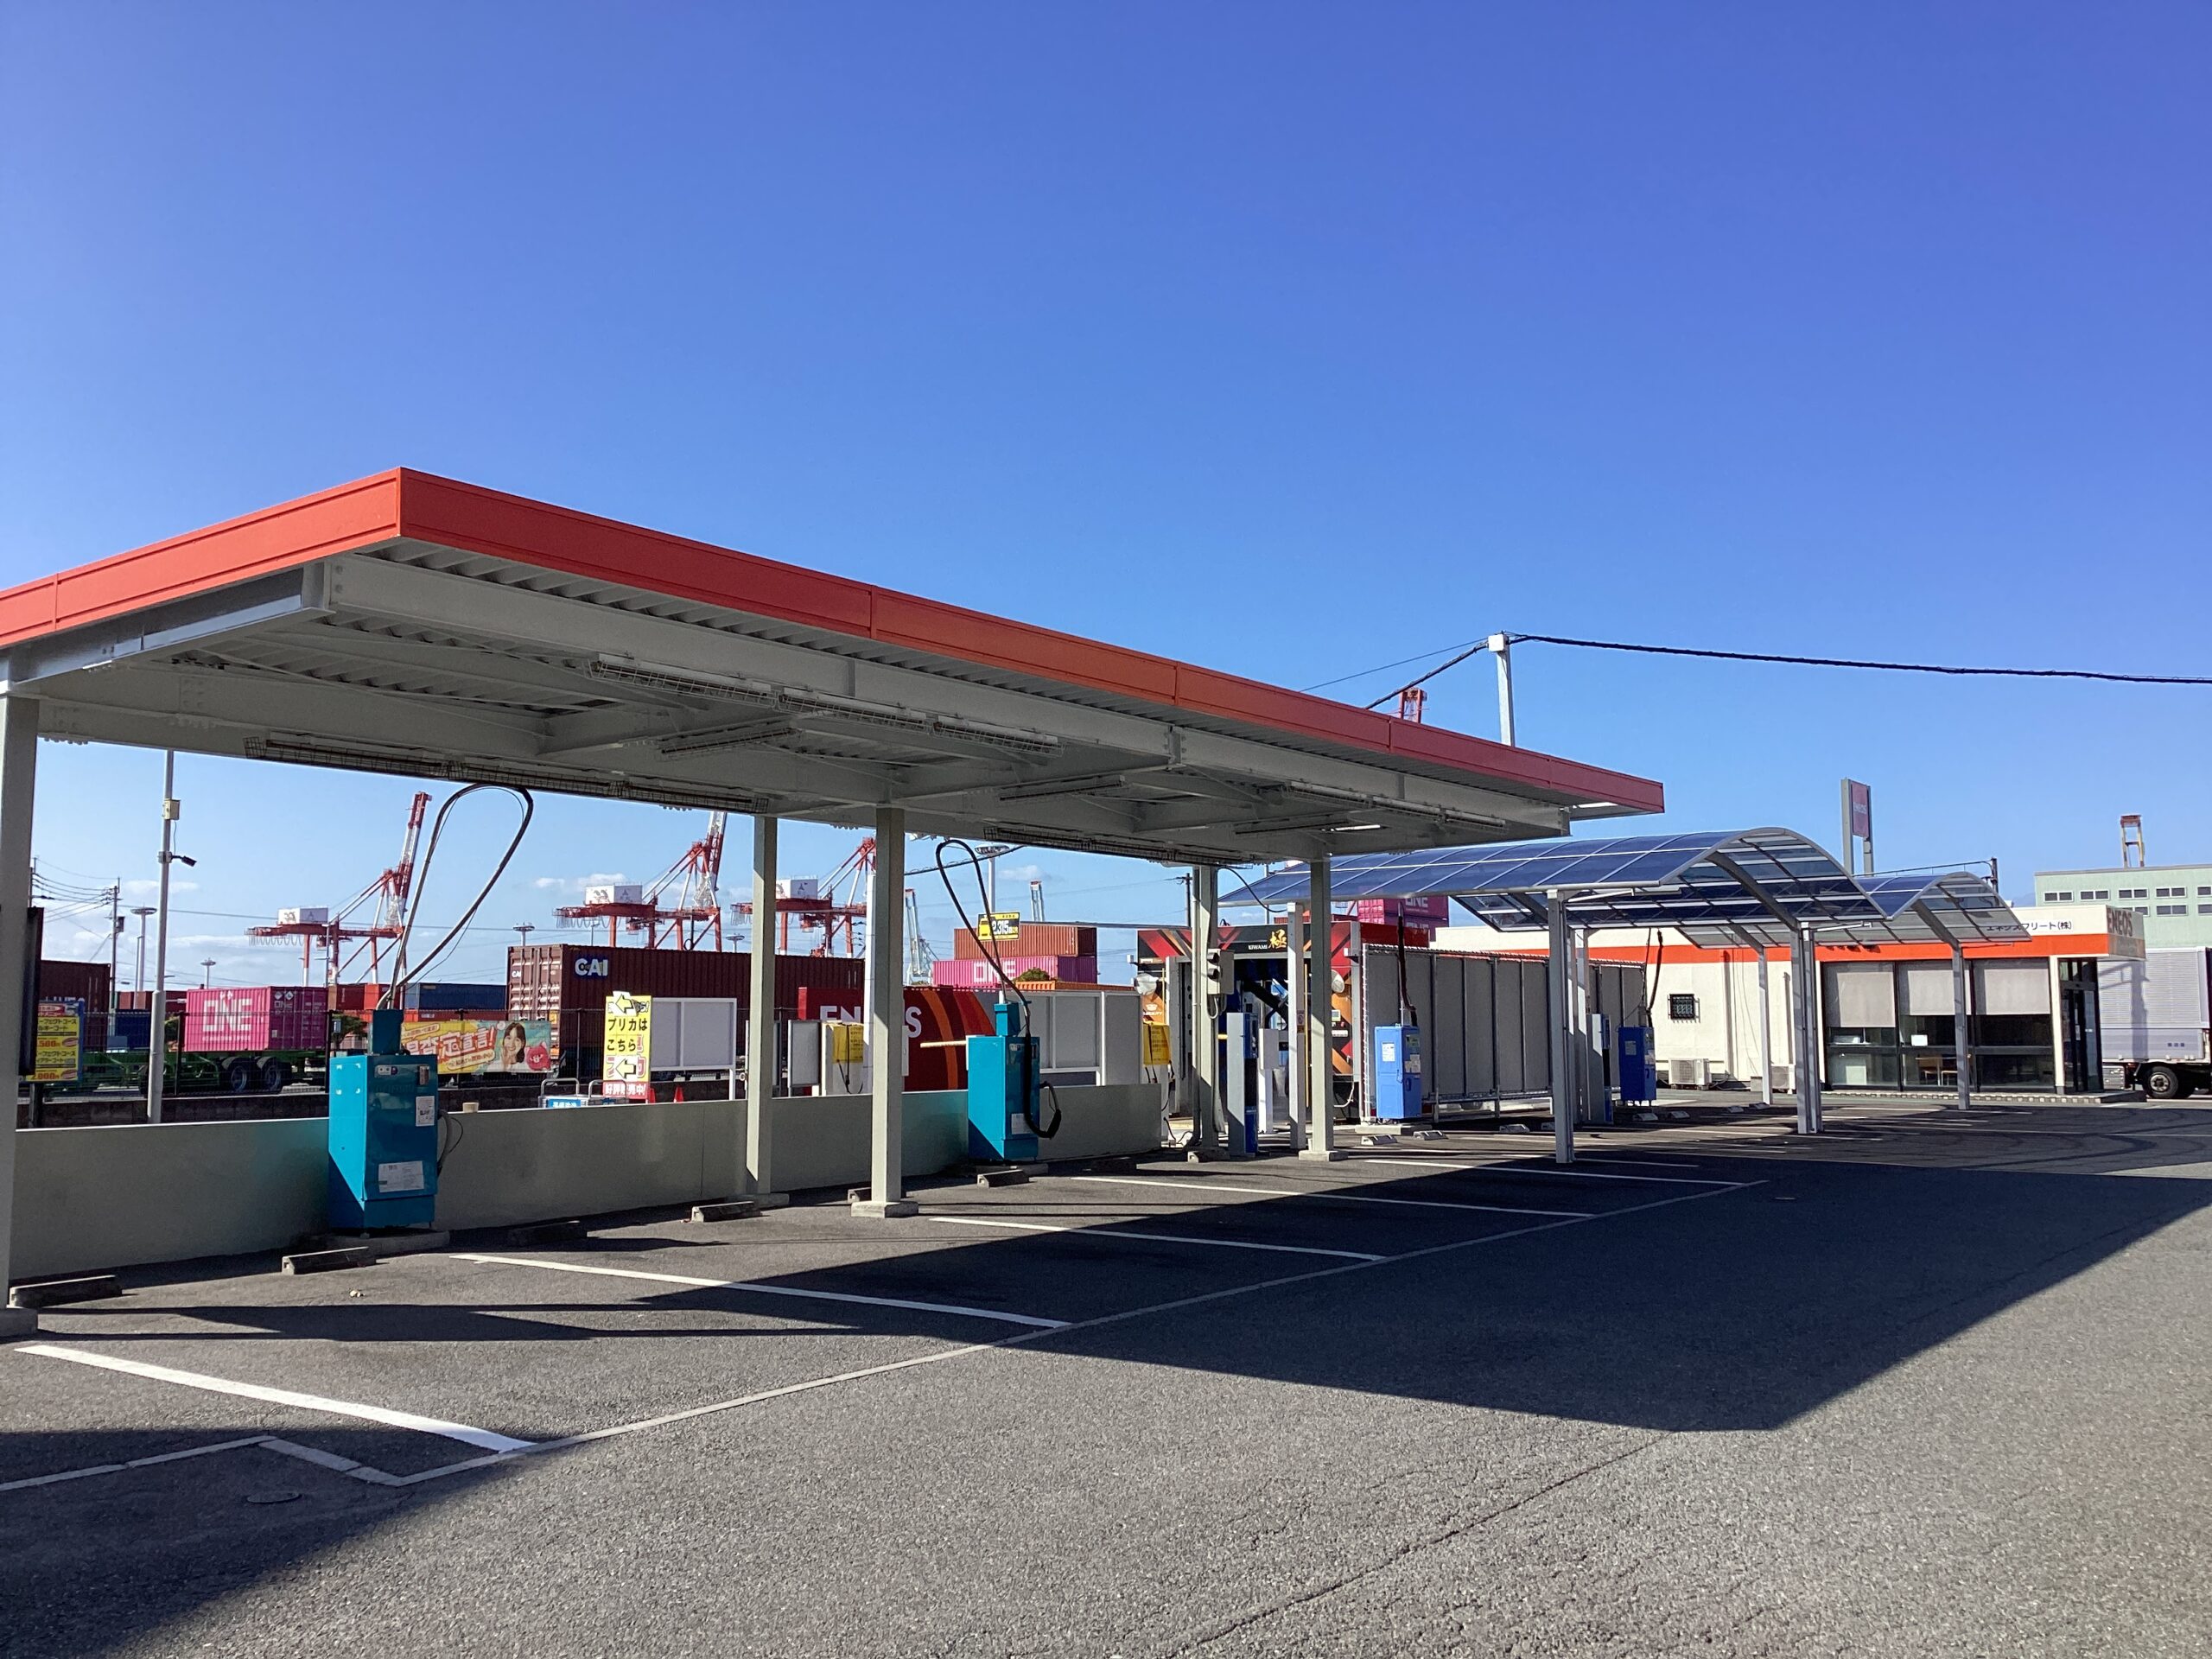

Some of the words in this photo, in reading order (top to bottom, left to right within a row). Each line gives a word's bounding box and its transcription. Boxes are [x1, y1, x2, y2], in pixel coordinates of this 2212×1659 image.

[2107, 908, 2133, 938] ENEOS
[575, 958, 608, 976] CAI
[973, 959, 1016, 983] ONE
[202, 998, 252, 1033] ONE
[607, 1039, 636, 1052] こちら
